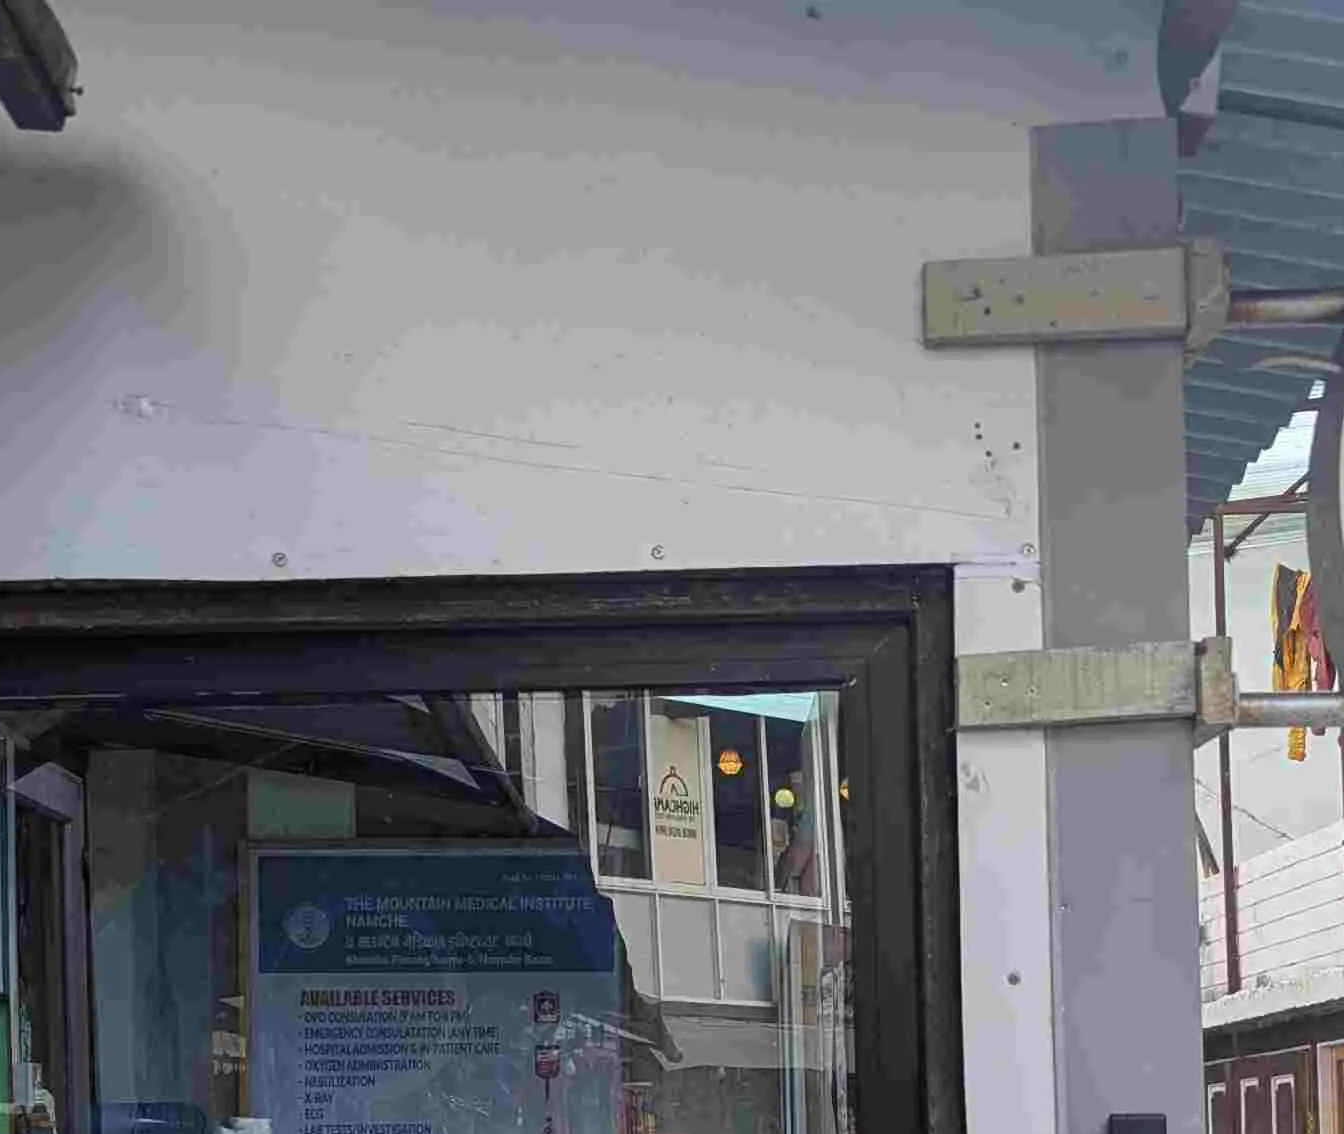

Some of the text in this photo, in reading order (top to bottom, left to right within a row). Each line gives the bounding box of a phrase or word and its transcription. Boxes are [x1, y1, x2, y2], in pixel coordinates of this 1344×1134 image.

[346, 915, 409, 928] NAMCHE
[300, 989, 457, 1007] AVAILABLE SERVICES
